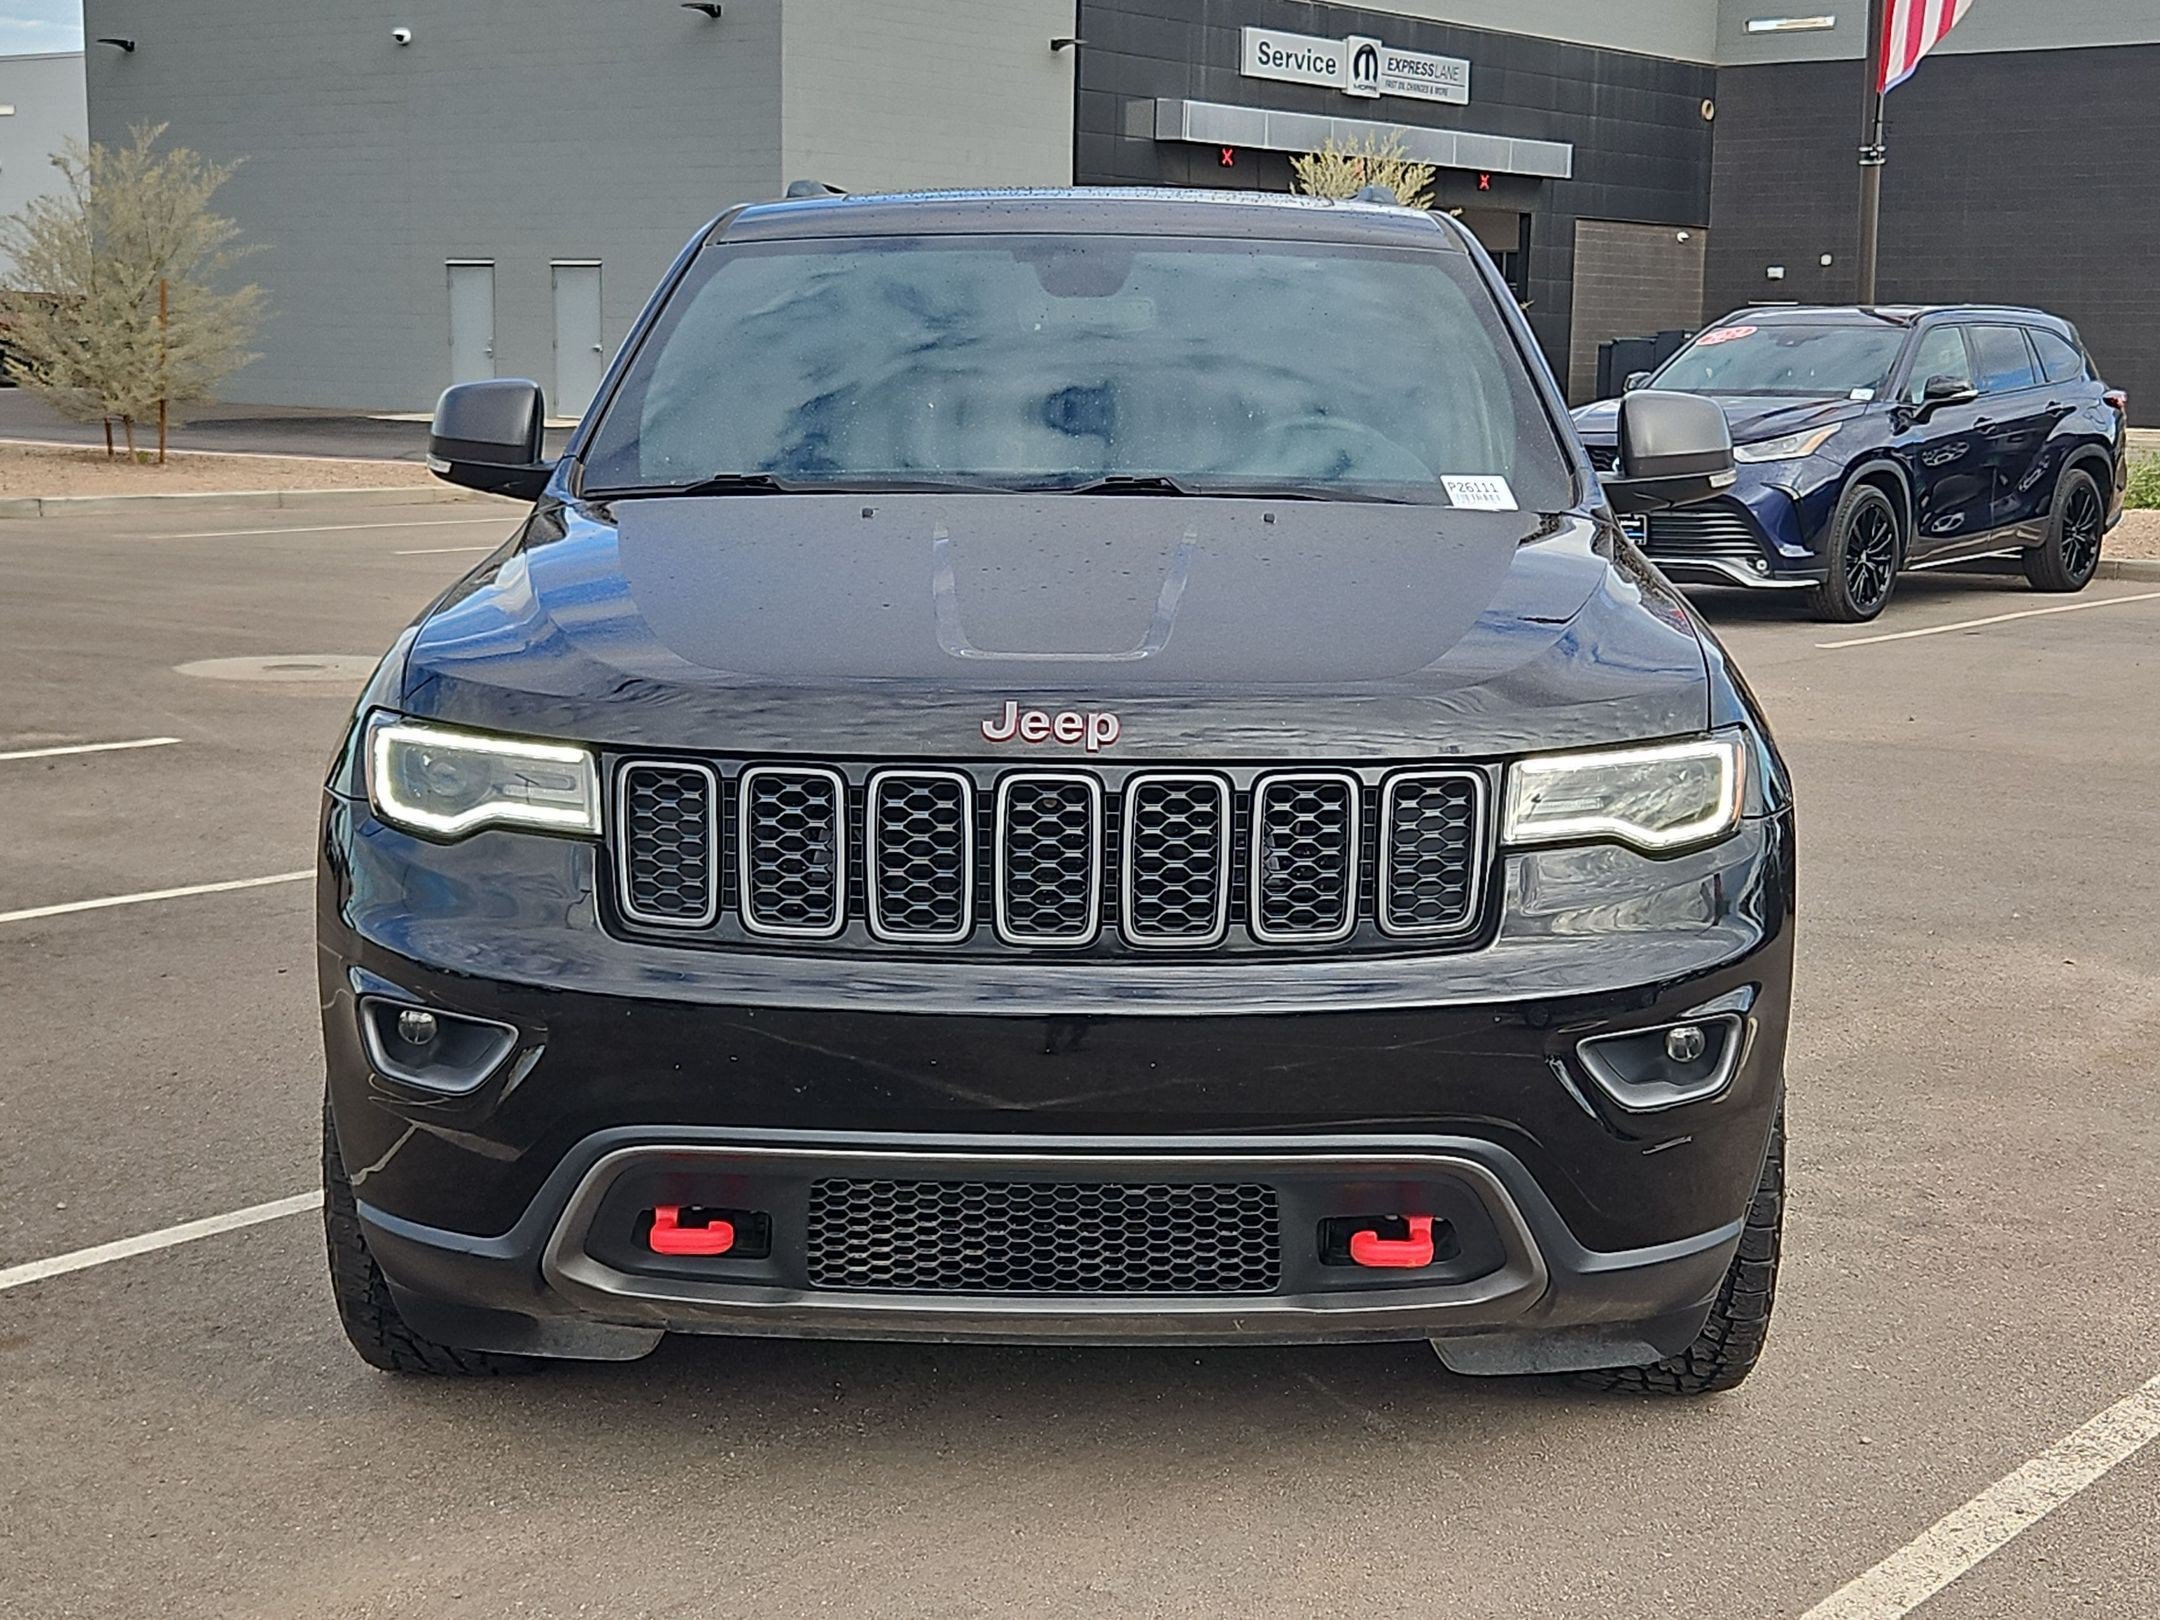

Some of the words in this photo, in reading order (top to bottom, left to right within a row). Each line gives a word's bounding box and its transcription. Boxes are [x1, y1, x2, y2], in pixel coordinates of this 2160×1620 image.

[1257, 40, 1337, 75] Service
[1447, 481, 1499, 493] P26111
[980, 699, 1121, 753] Jeep
